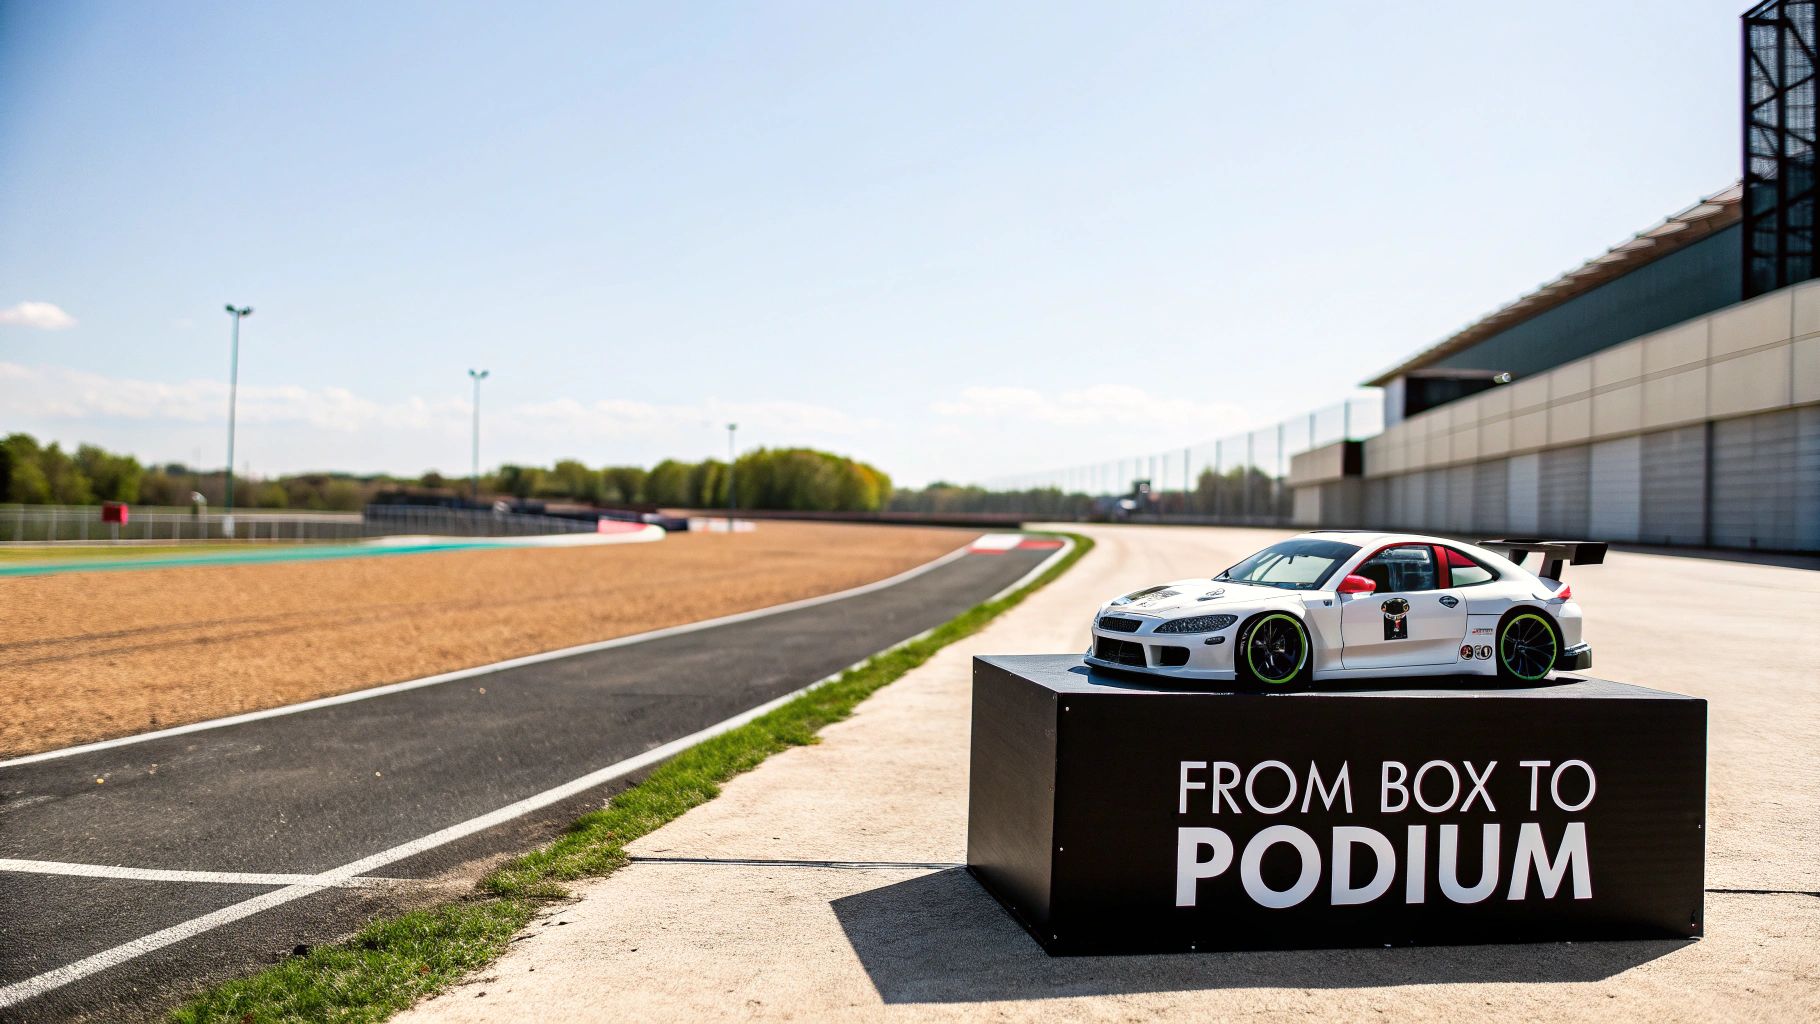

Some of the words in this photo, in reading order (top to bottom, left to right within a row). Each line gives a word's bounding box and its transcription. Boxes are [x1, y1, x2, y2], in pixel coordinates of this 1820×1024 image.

[1179, 760, 1353, 815] FROM
[1380, 760, 1498, 814] BOX
[1519, 760, 1597, 812] TO
[1175, 821, 1593, 909] PODIUM
